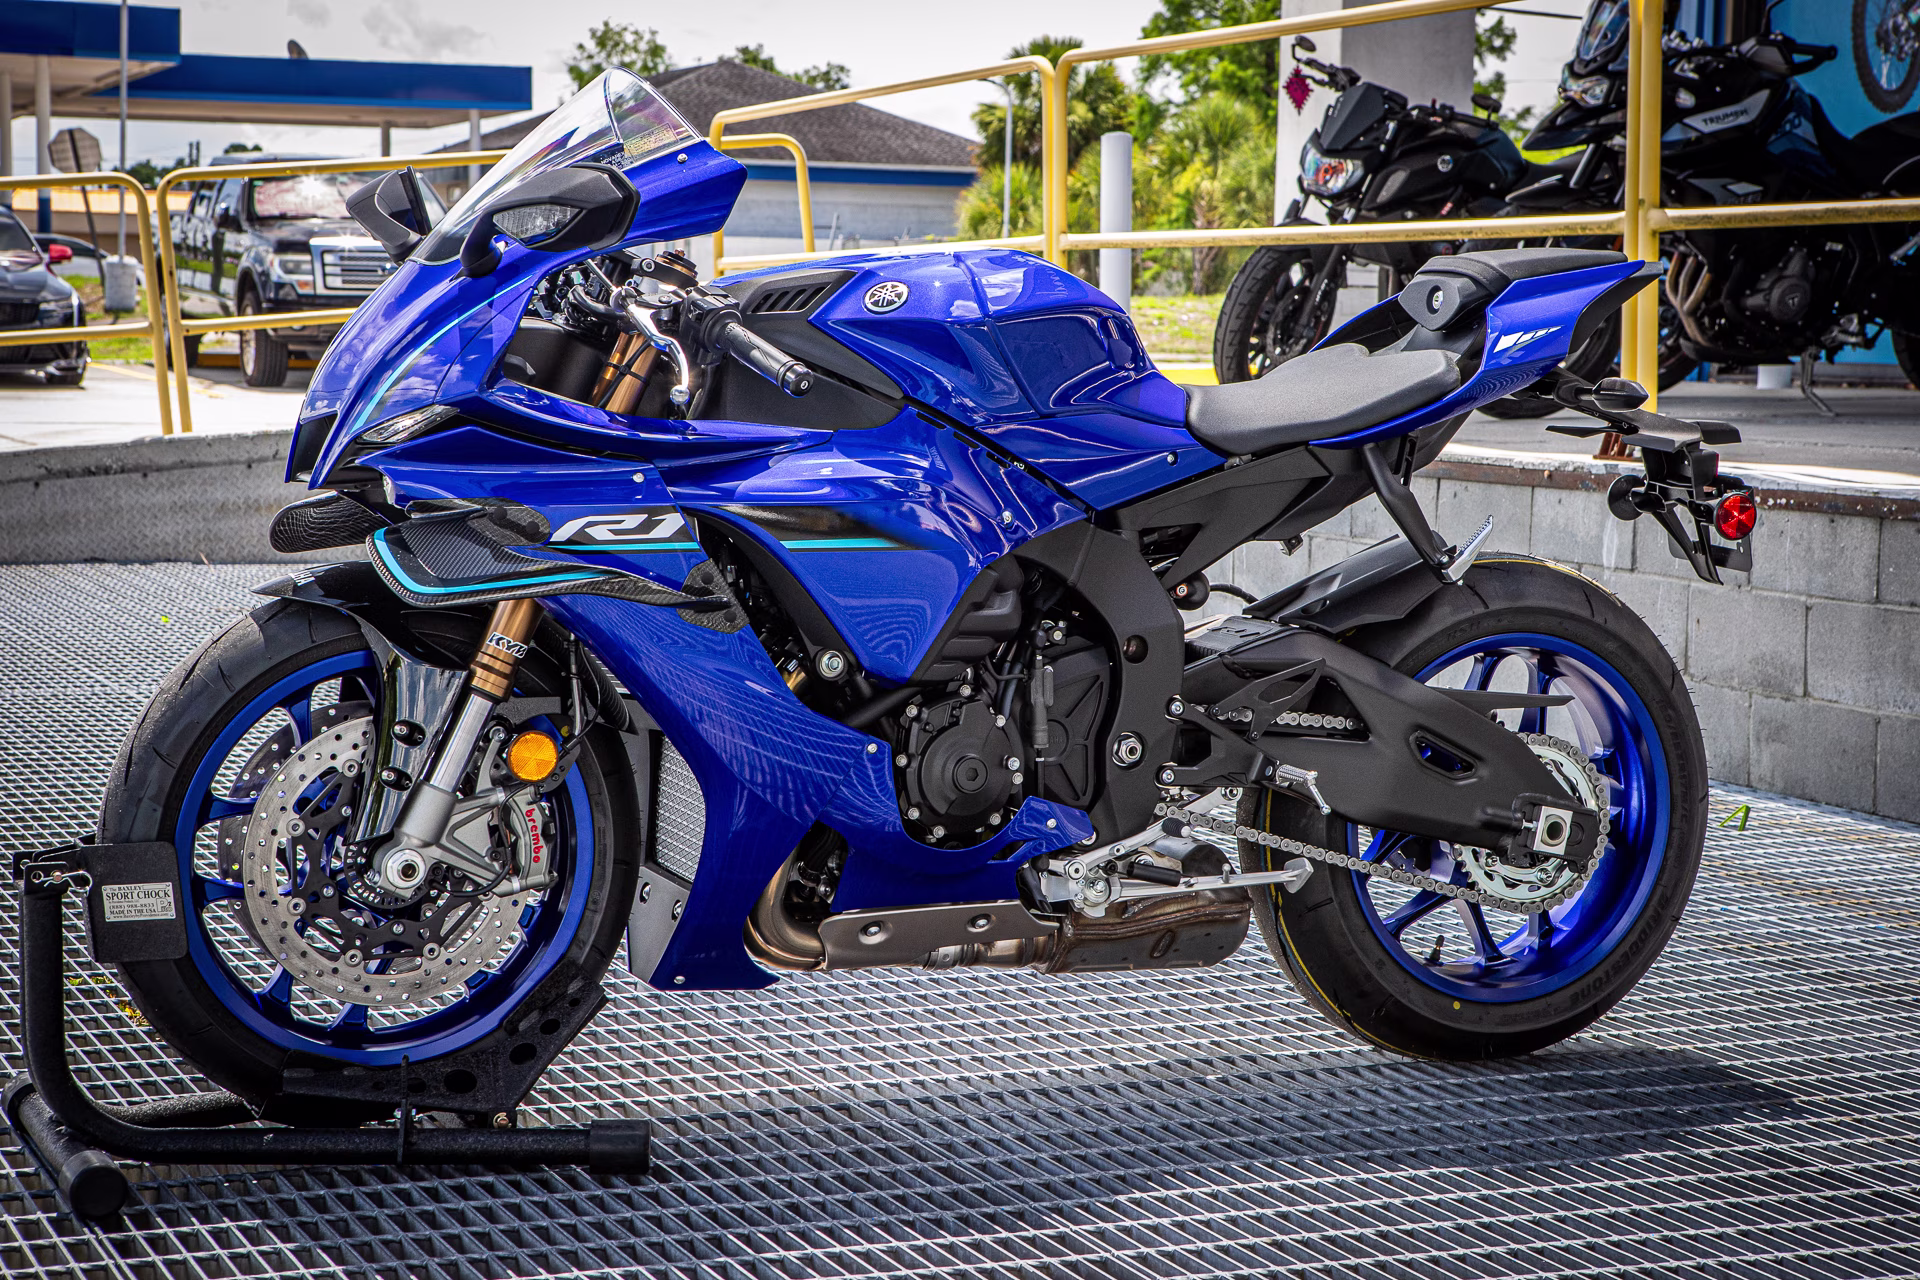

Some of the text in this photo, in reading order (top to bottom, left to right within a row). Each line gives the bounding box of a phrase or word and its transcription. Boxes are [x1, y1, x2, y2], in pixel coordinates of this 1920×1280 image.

[1701, 108, 1749, 127] TRIUMPH
[550, 512, 685, 542] R1
[525, 807, 545, 864] brembo
[105, 889, 171, 900] SPORT CHOCK
